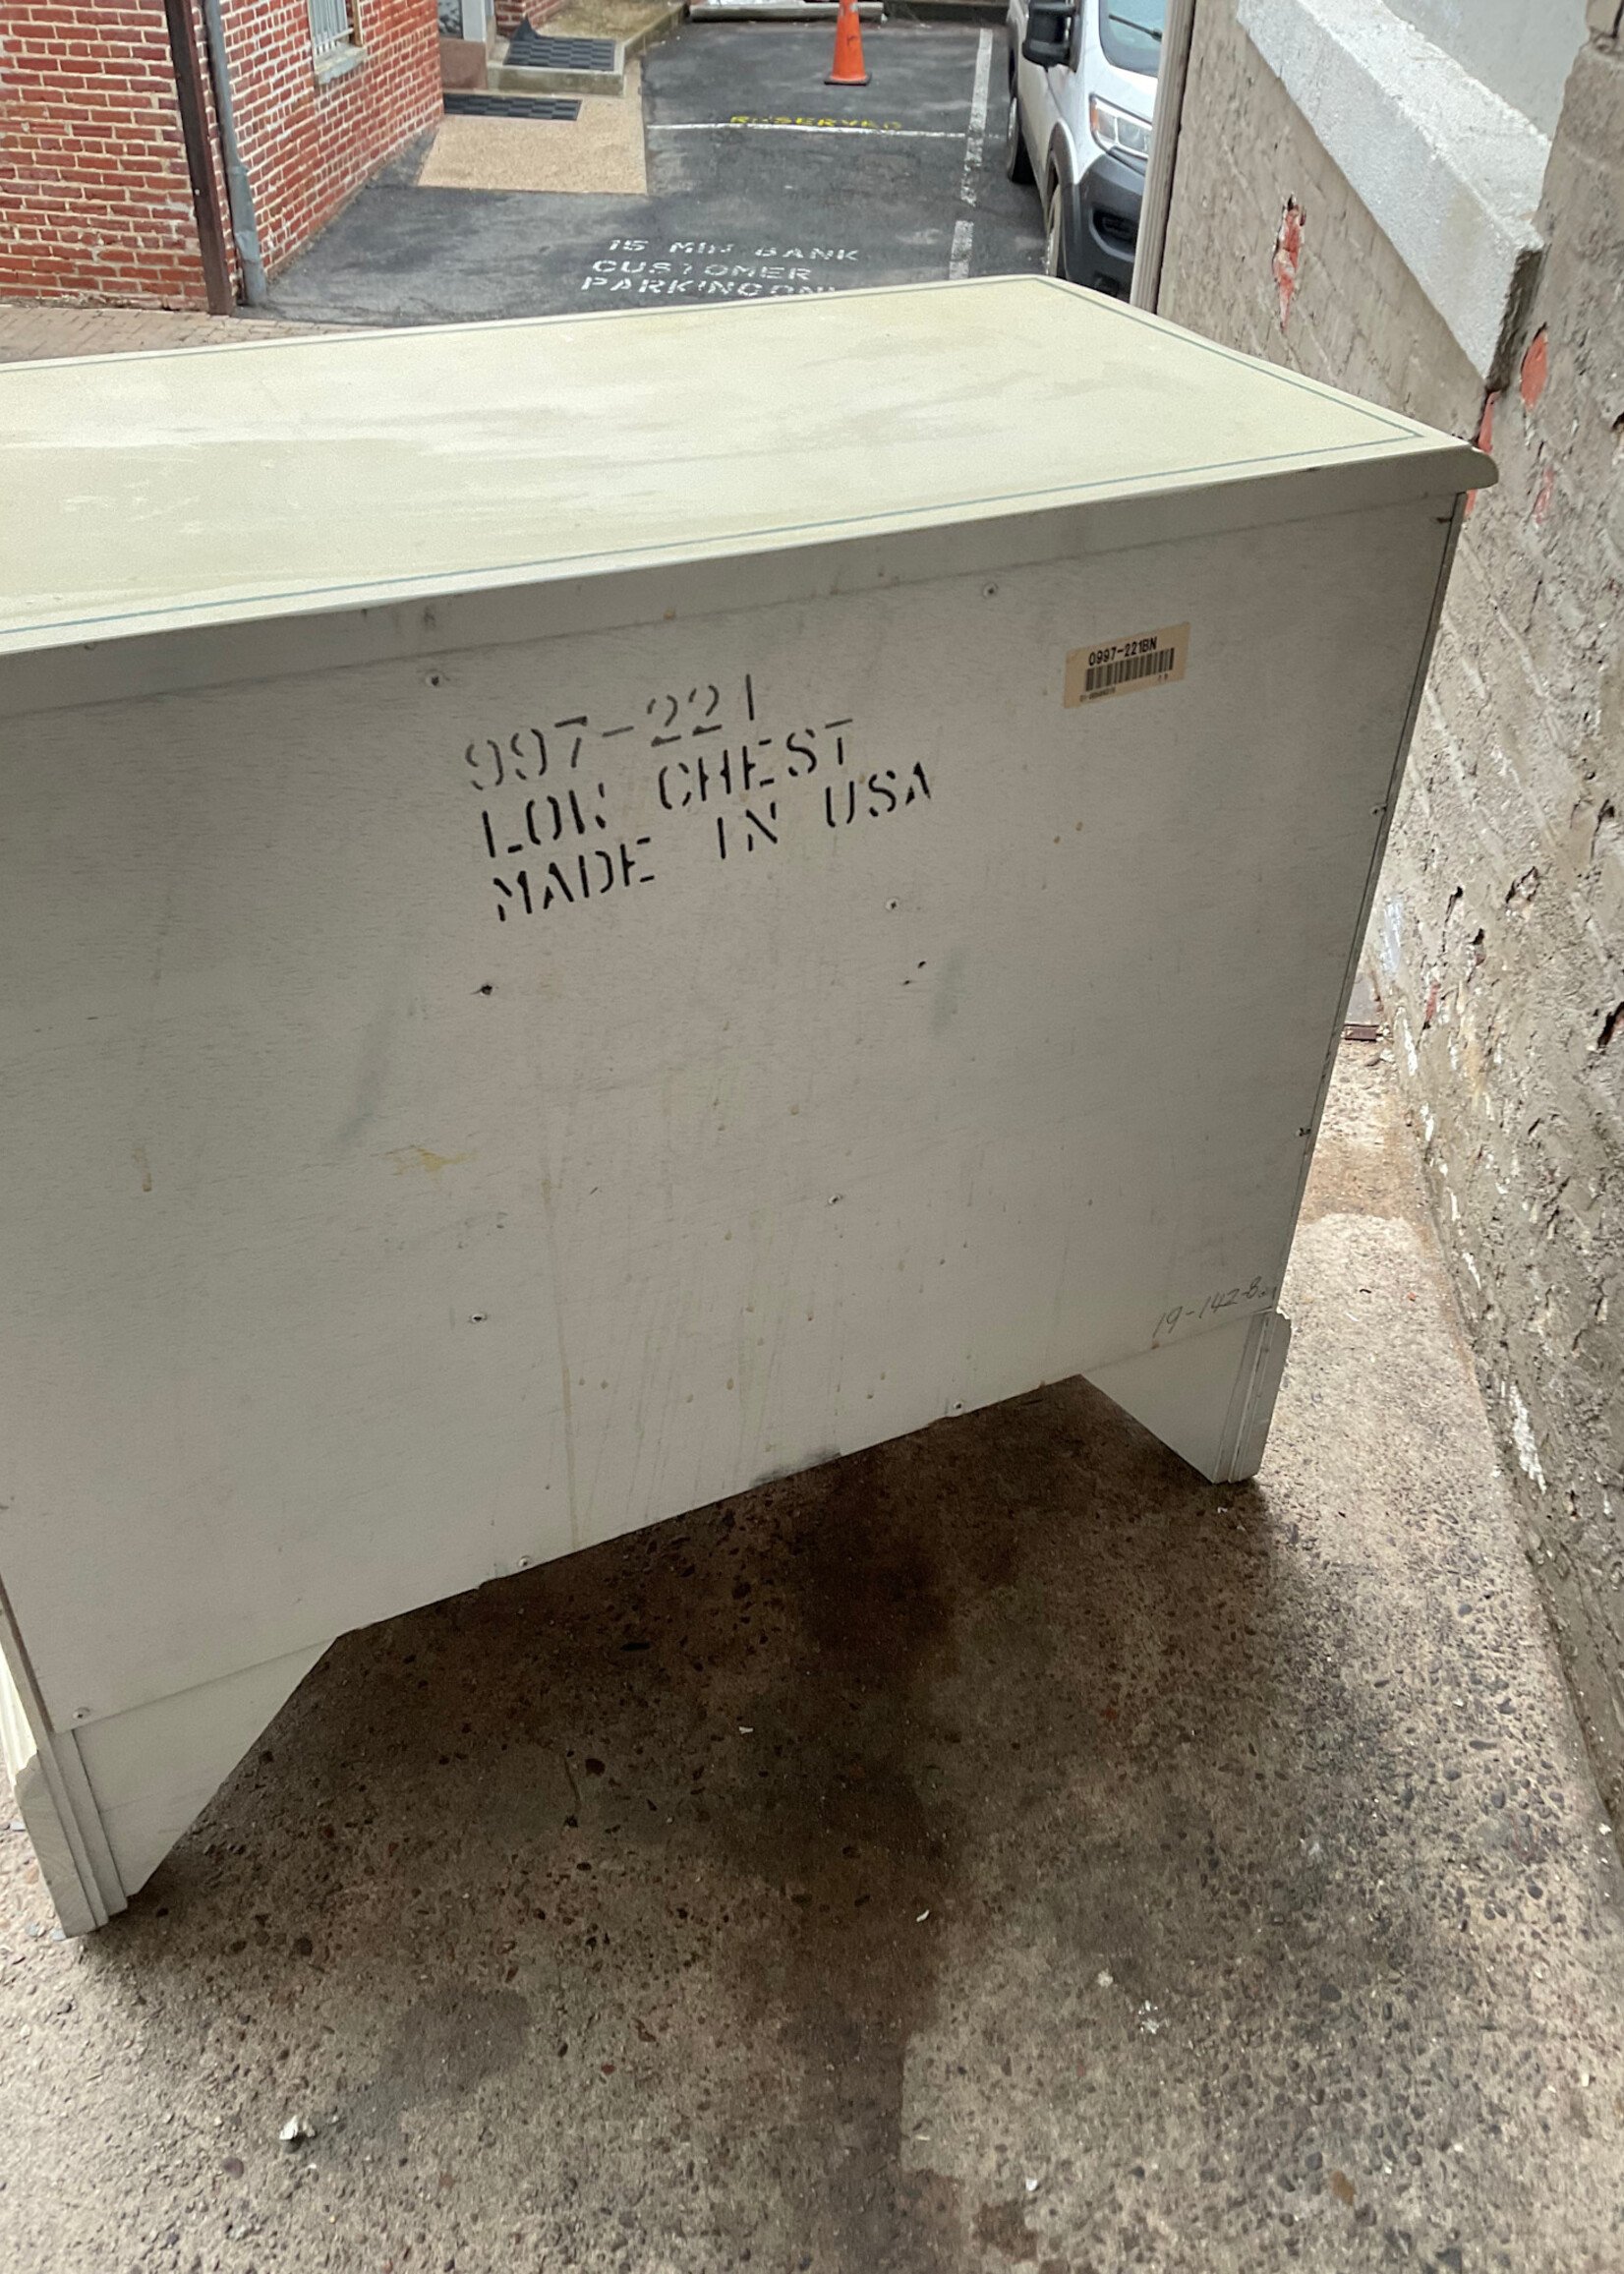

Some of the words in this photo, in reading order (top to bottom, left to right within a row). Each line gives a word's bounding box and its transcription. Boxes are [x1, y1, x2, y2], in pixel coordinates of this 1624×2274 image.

[592, 260, 812, 281] CUSTOMER
[609, 239, 649, 252] 15
[754, 247, 859, 262] BANK
[1087, 636, 1158, 667] 0997-221BN
[465, 673, 755, 790] 997-221
[482, 784, 607, 858] LOW
[658, 719, 854, 809] CHEST
[493, 837, 656, 922] MADE
[717, 801, 779, 860] IN
[825, 762, 932, 829] USA
